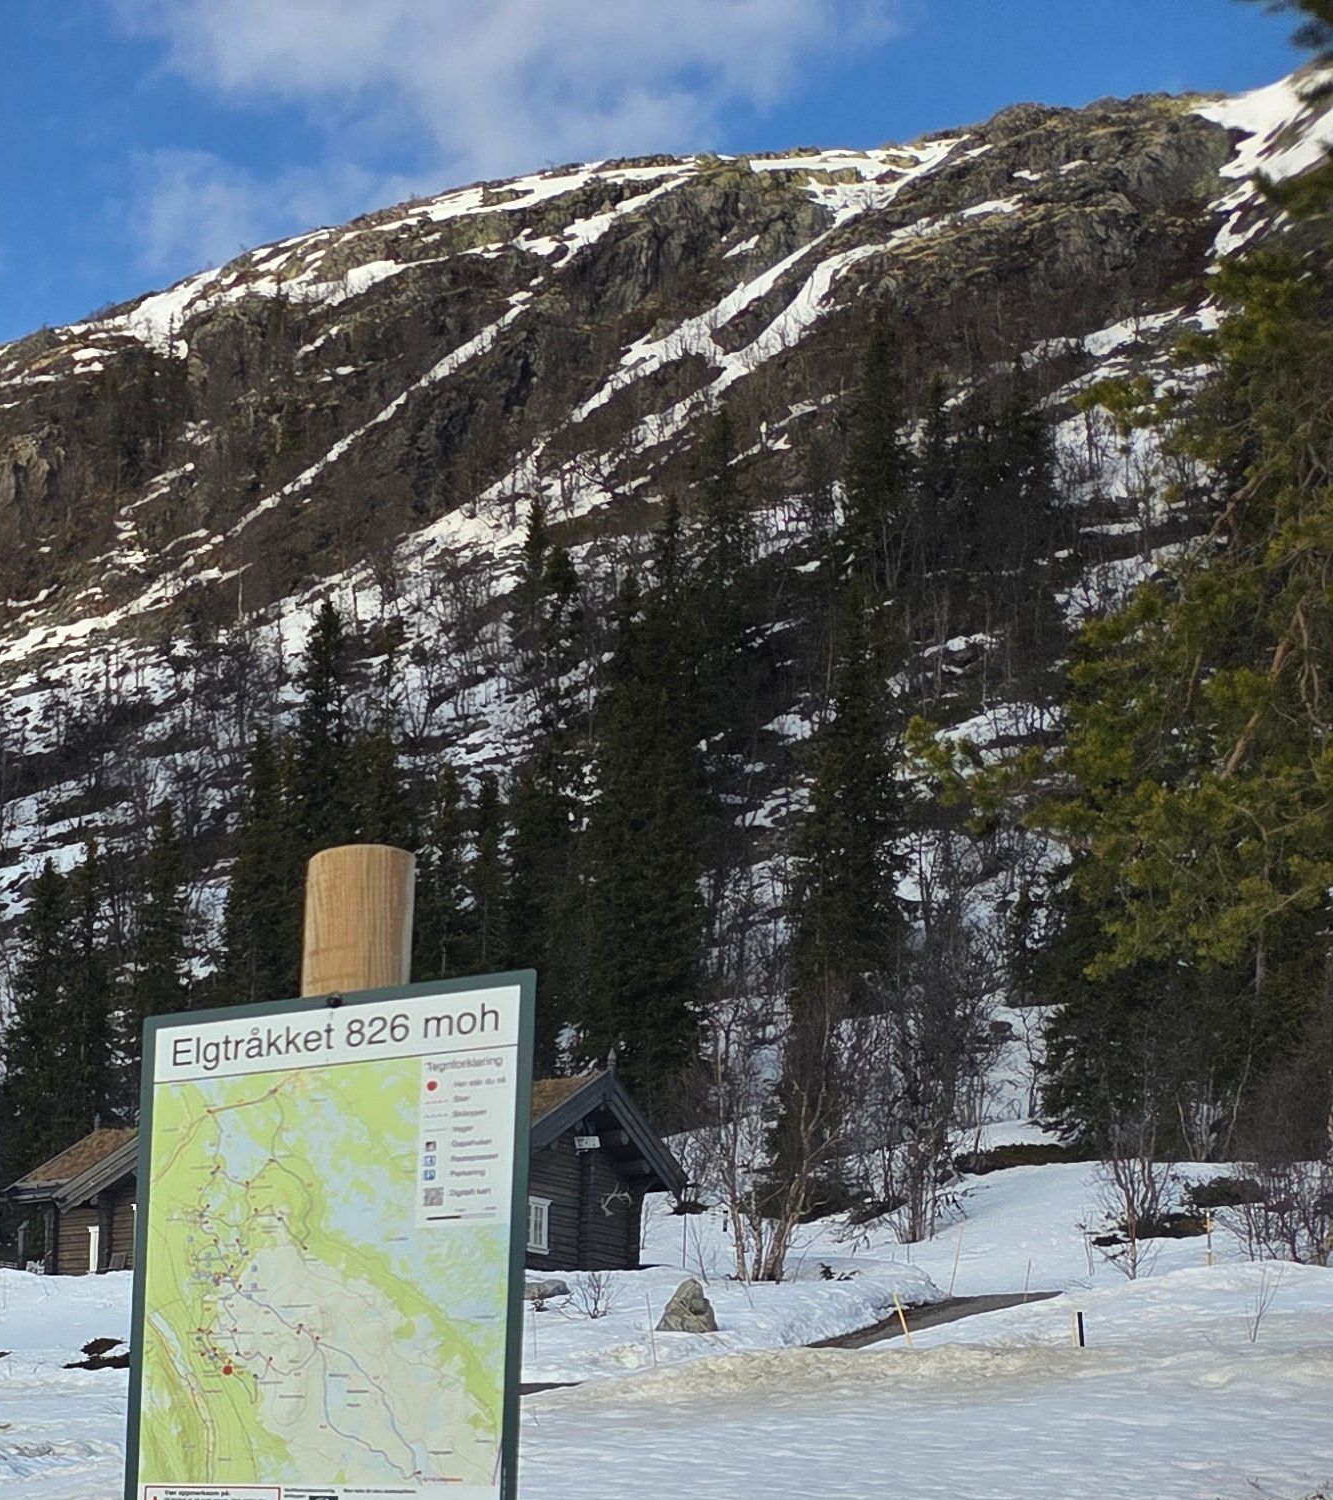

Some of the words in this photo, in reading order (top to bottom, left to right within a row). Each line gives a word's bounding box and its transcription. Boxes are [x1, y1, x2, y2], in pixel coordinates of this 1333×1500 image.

[172, 1023, 334, 1071] Elgtråkket
[346, 1013, 410, 1048] 826
[423, 1002, 499, 1039] moh
